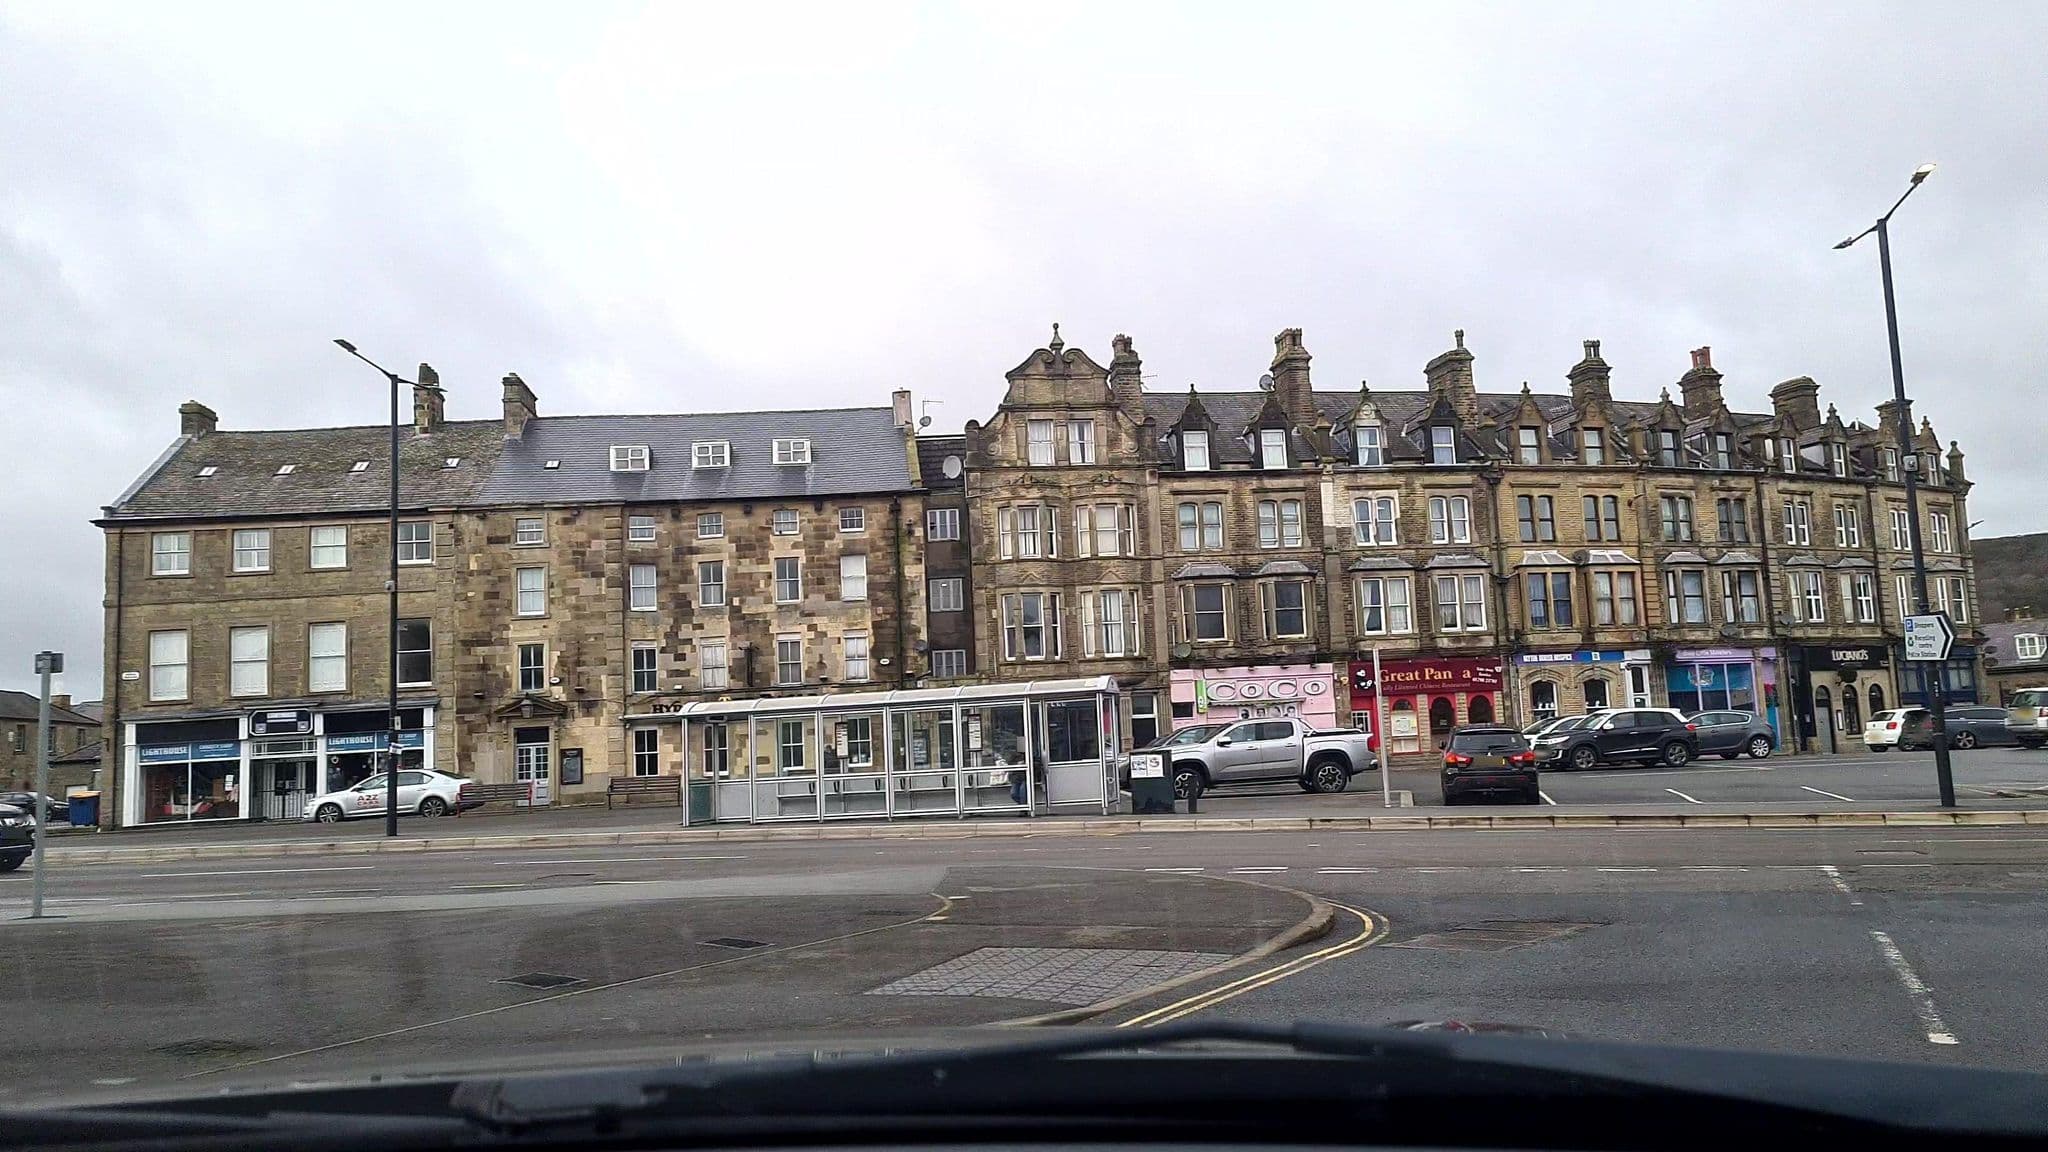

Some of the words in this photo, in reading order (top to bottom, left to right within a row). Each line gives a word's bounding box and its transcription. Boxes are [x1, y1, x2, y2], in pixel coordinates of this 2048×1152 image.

[1380, 668, 1420, 682] Great
[328, 735, 374, 745] LIGHTHOUSE
[142, 746, 187, 756] LIGHTHOUSE
